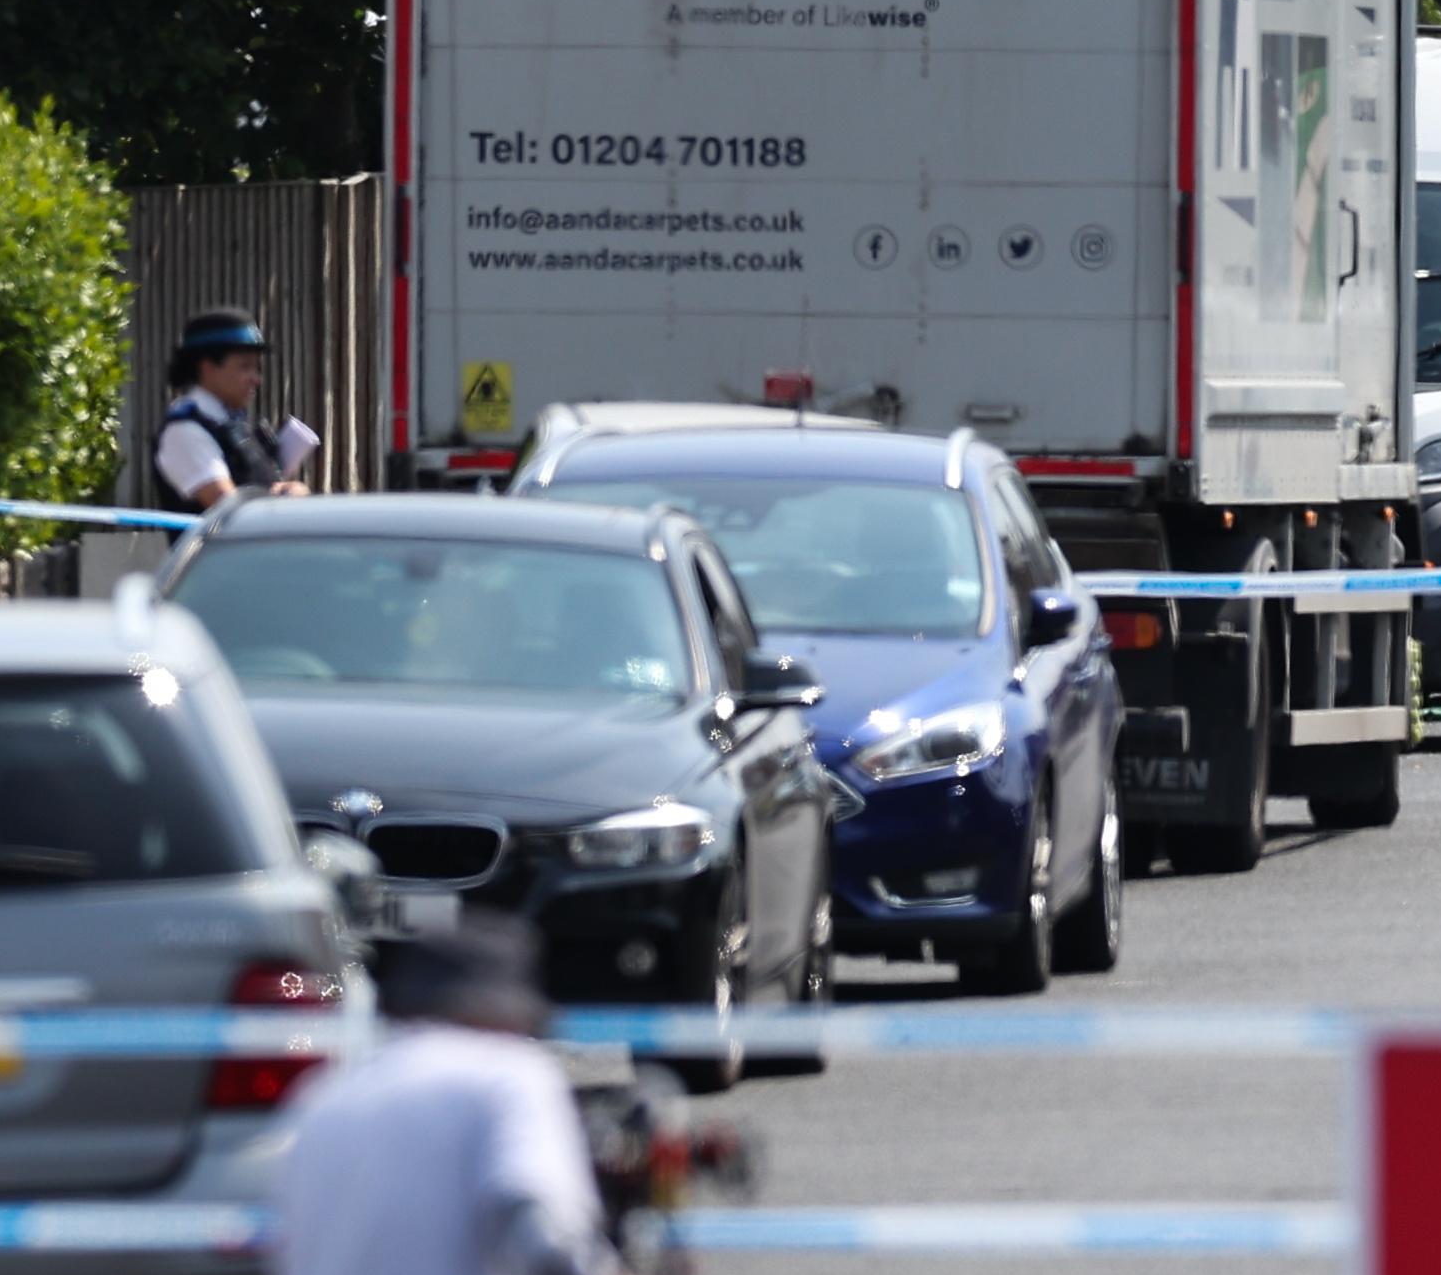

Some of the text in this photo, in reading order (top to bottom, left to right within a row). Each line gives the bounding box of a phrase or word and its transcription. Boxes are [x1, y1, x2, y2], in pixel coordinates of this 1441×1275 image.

[469, 131, 807, 167] Tel: 01204 701188
[467, 205, 805, 236] info@aandacarpets.co.uk
[468, 247, 804, 276] www.aandacarpets.co.uk
